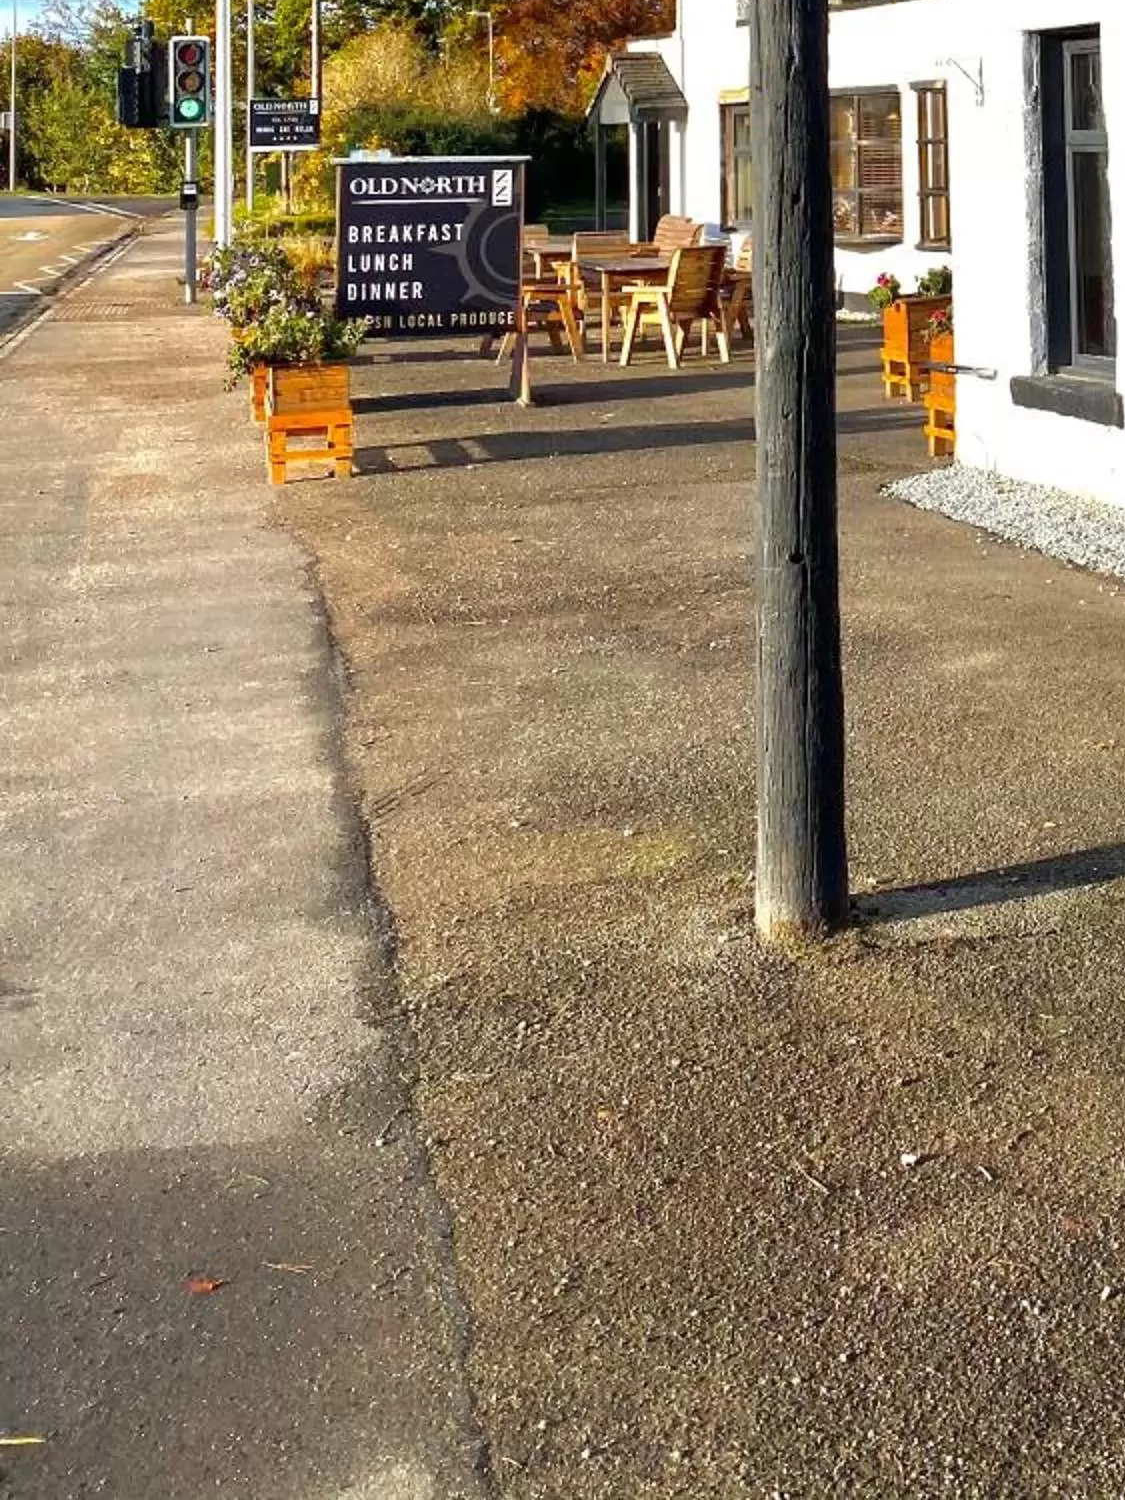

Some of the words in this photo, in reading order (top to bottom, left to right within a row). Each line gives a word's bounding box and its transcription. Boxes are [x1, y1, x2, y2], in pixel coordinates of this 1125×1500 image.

[348, 223, 464, 244] BREAKFAST
[348, 253, 414, 273] LUNCH
[347, 281, 423, 301] DINNER
[399, 313, 444, 328] LOCAL
[451, 311, 515, 326] PRODUCE
